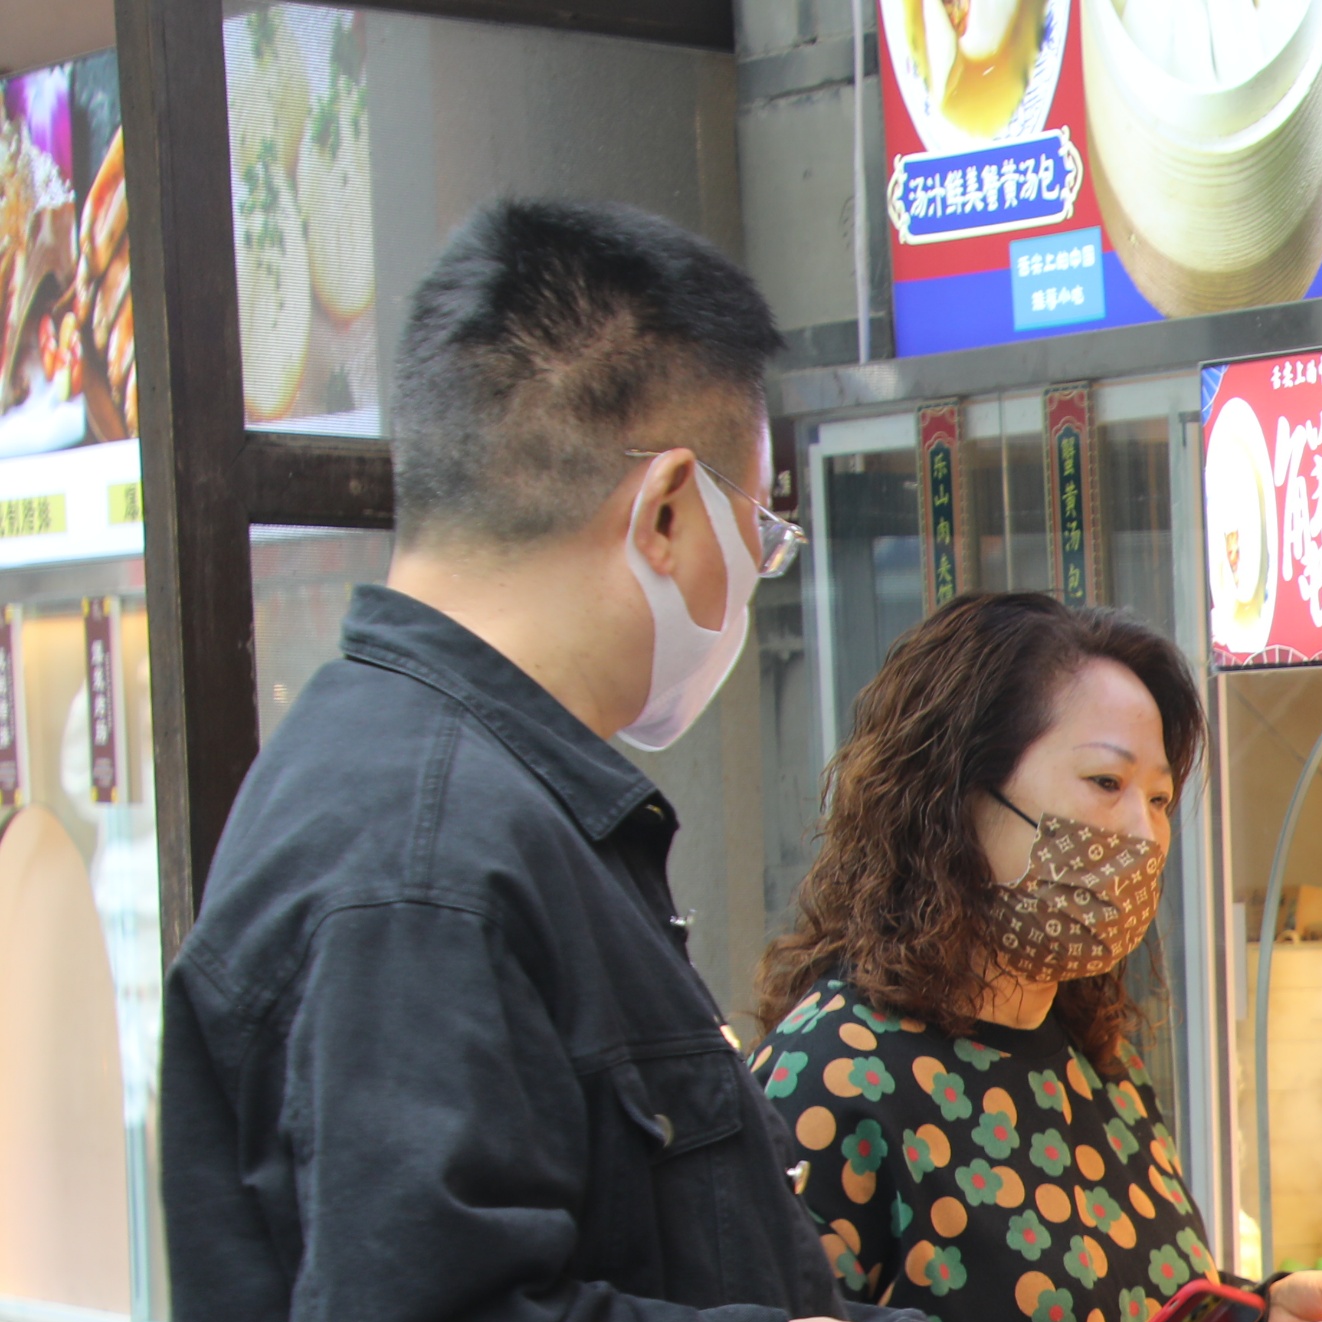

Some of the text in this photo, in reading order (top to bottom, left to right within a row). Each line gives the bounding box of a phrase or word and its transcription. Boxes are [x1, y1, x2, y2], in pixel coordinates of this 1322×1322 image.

[908, 153, 1060, 219] 汤汁鲜美蟹黄汤包
[1061, 436, 1083, 599] 蟹黄汤包
